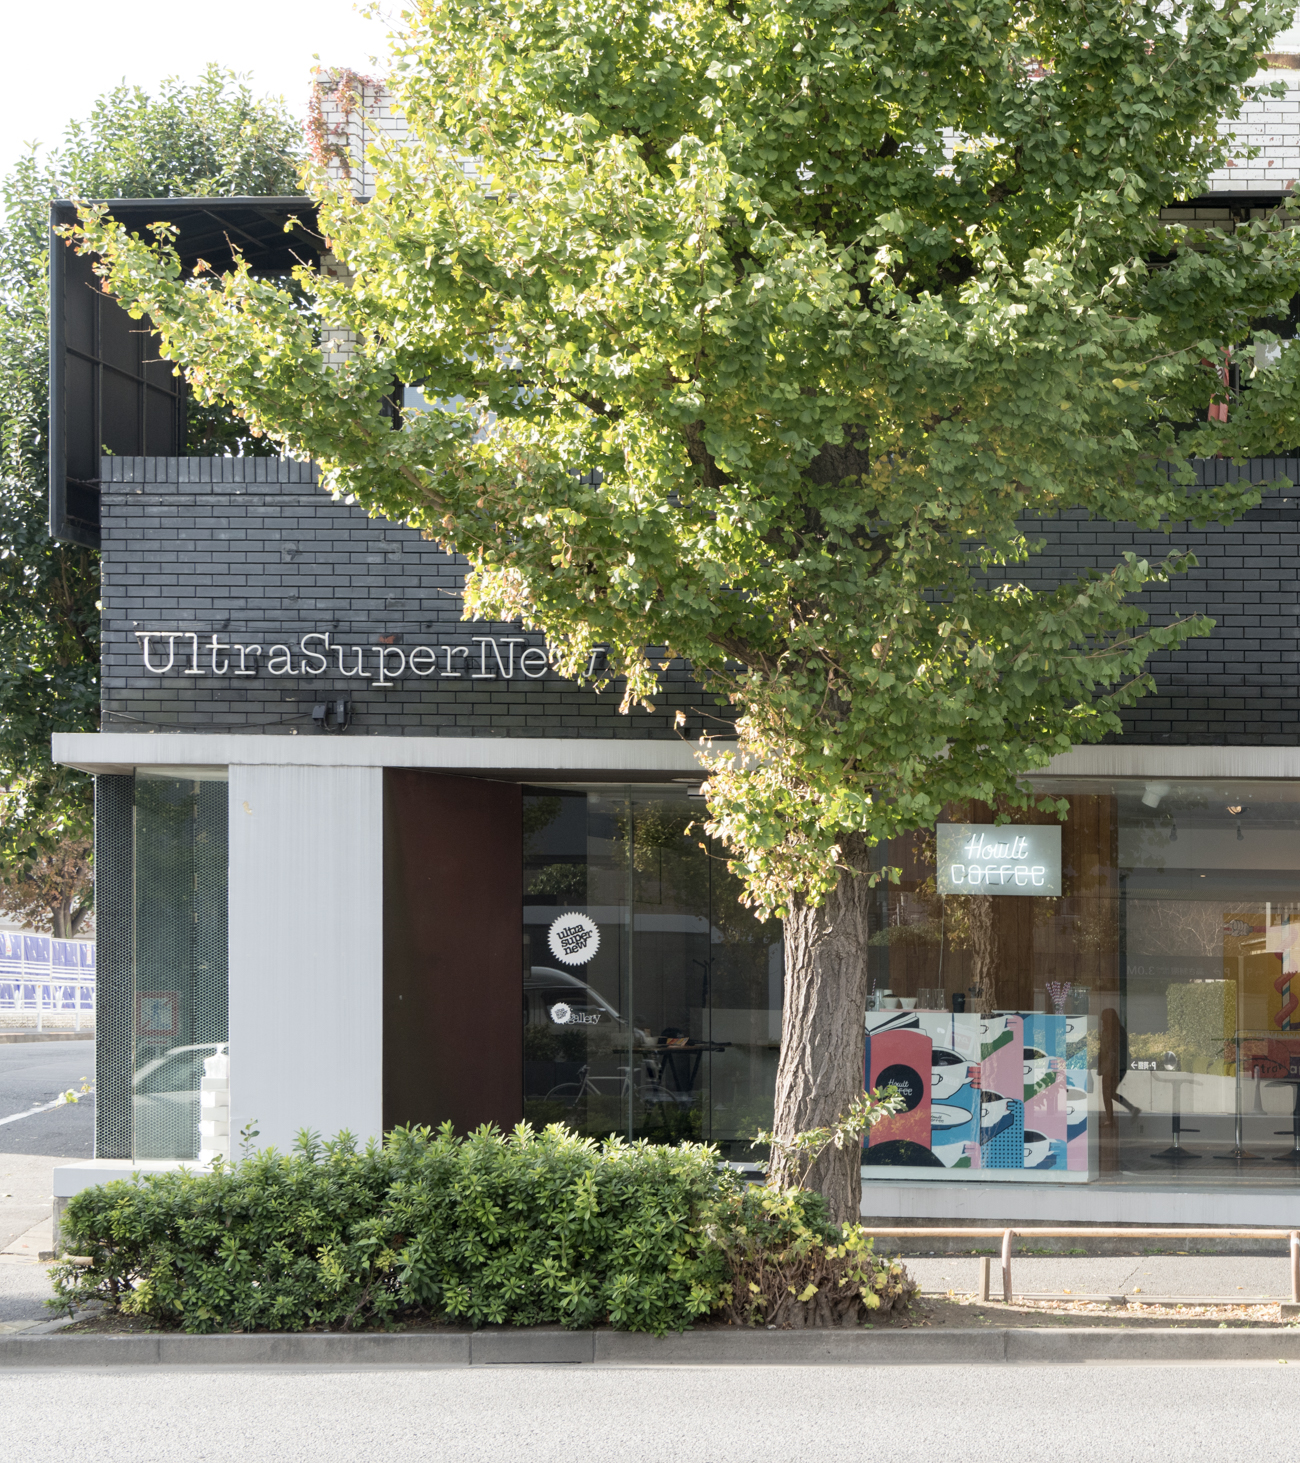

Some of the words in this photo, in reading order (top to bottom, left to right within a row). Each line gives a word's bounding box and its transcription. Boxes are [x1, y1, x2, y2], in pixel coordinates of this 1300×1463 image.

[556, 924, 586, 940] ultra
[560, 929, 593, 948] super
[563, 938, 588, 956] new
[567, 1012, 601, 1025] gallery
